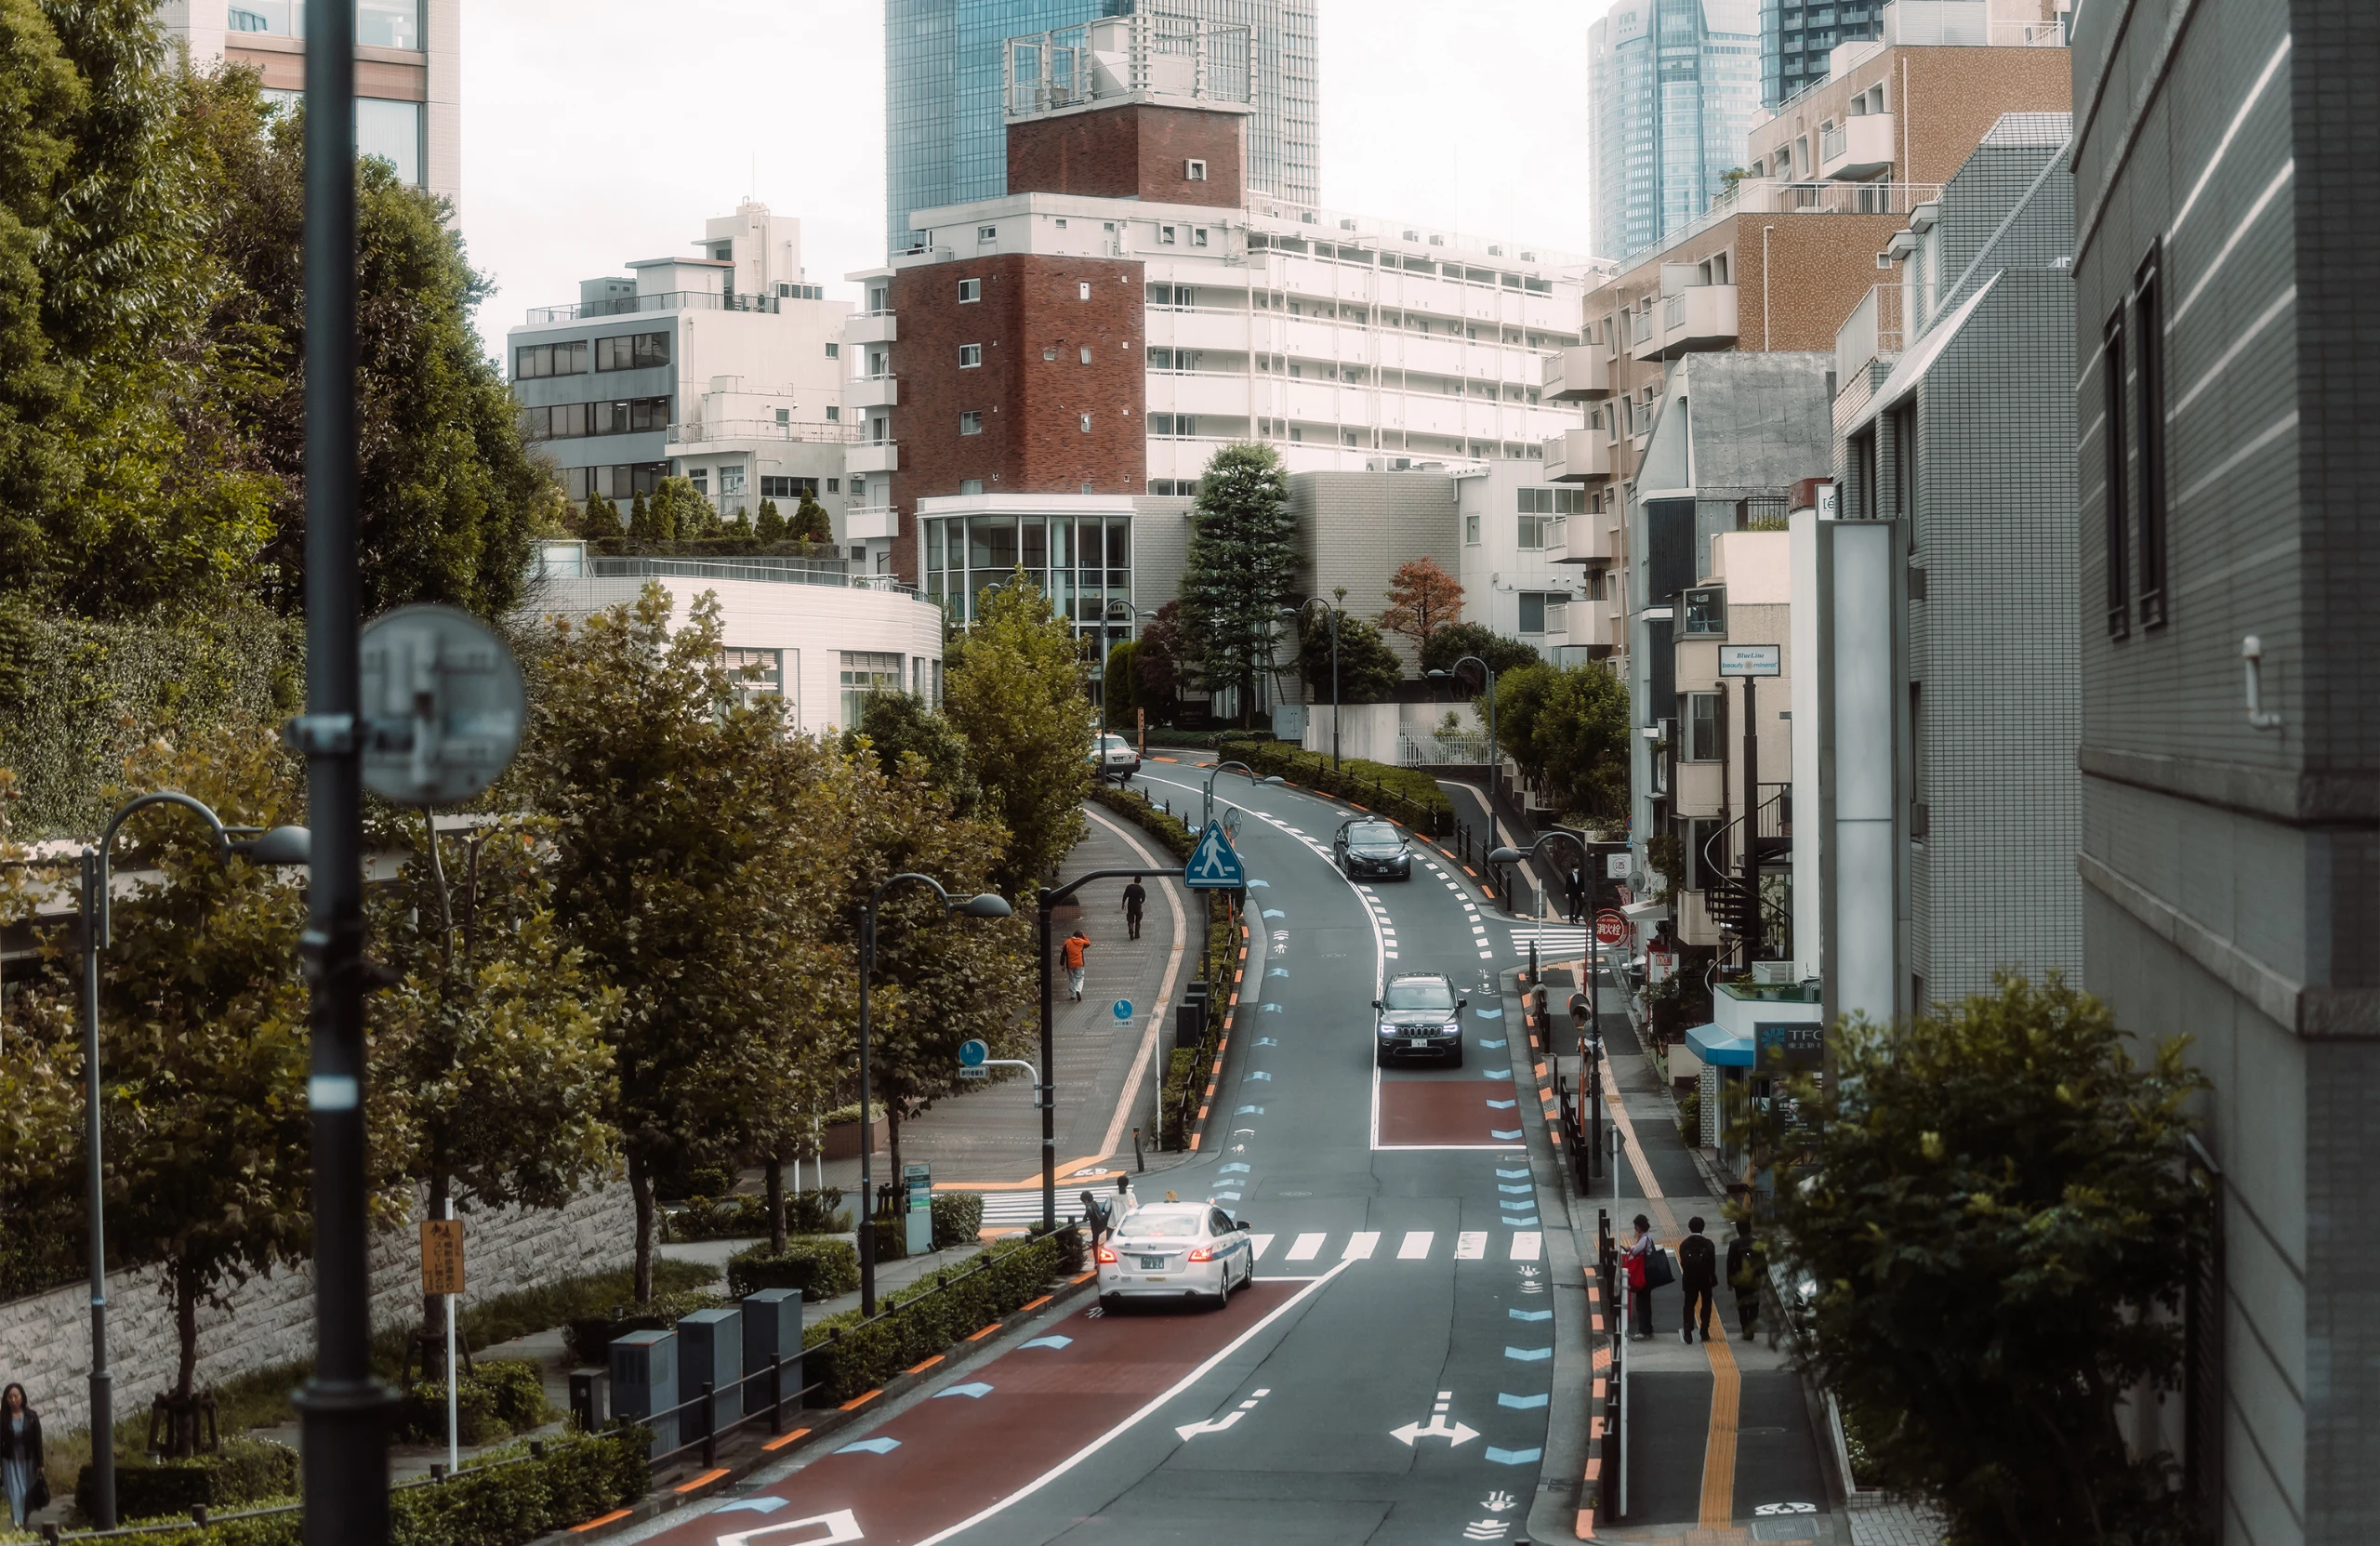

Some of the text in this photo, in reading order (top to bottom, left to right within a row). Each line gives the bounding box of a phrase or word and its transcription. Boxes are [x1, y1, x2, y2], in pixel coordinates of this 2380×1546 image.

[1615, 861, 1625, 869] 酒
[1596, 923, 1621, 936] 消火栓
